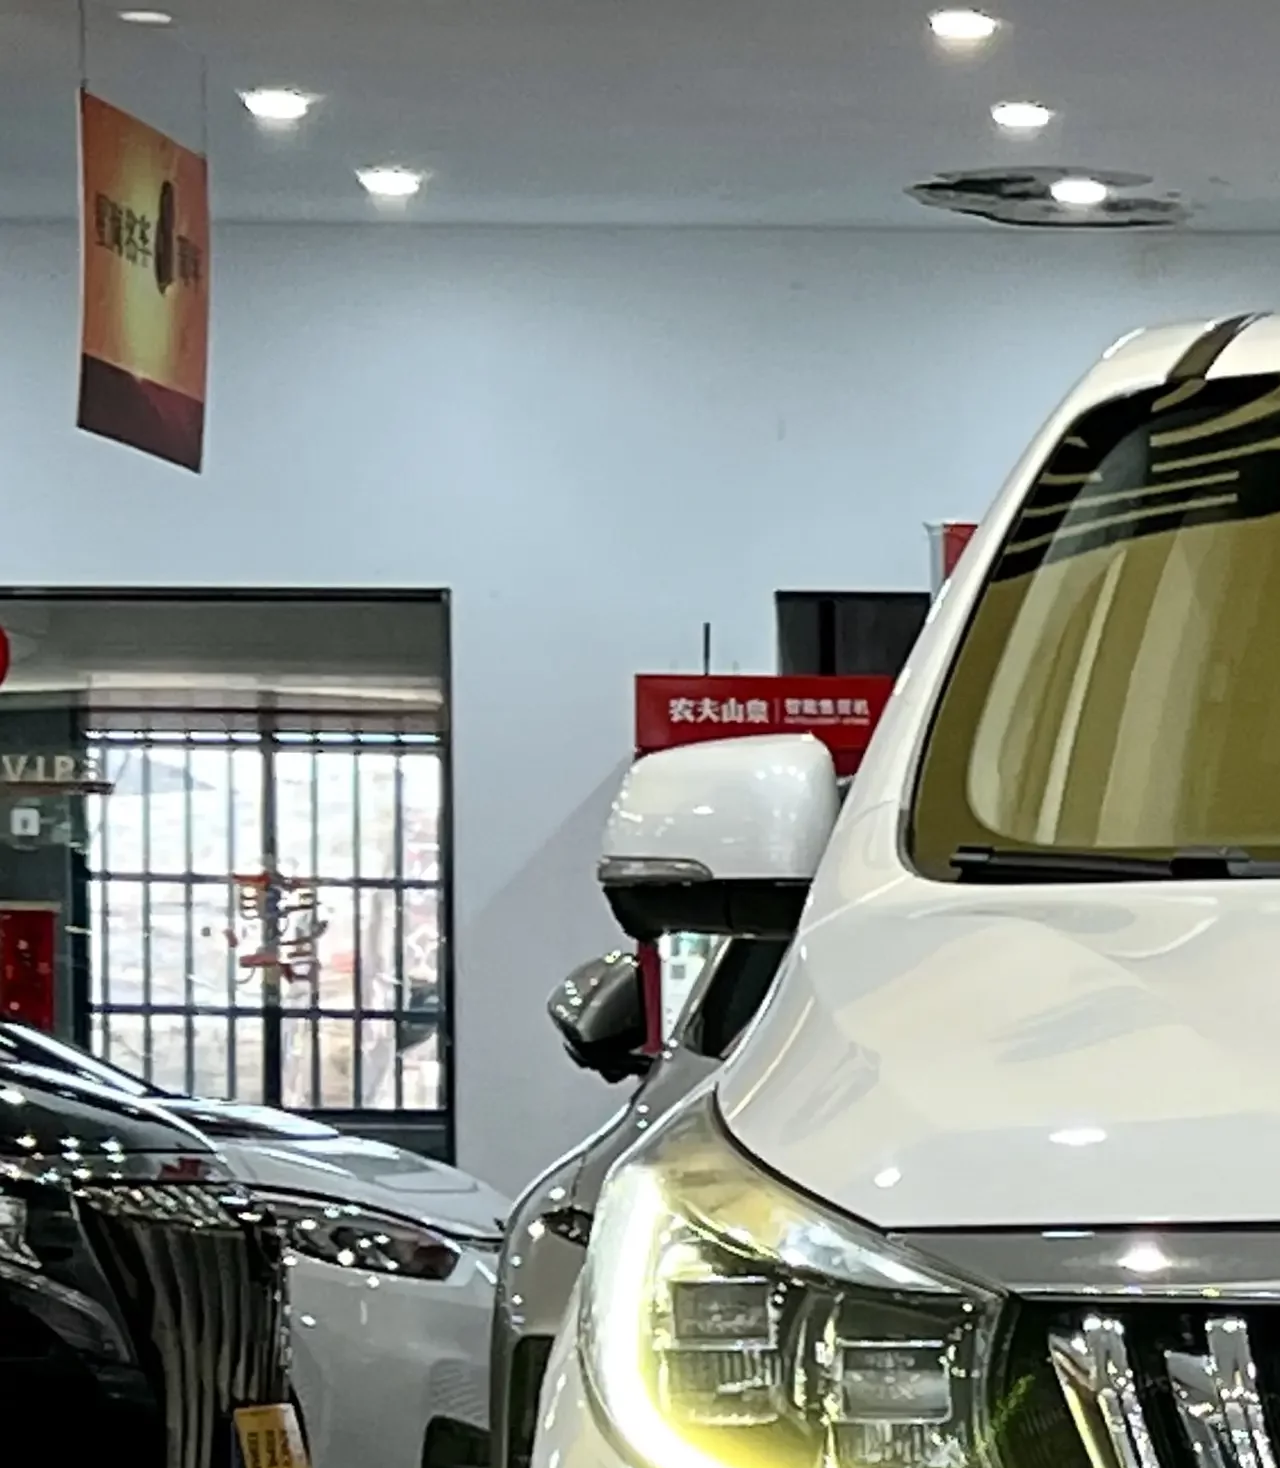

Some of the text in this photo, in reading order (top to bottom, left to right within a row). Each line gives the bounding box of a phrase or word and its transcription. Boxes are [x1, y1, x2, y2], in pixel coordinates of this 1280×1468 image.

[669, 697, 769, 723] 农夫山泉
[1, 755, 76, 782] VIP
